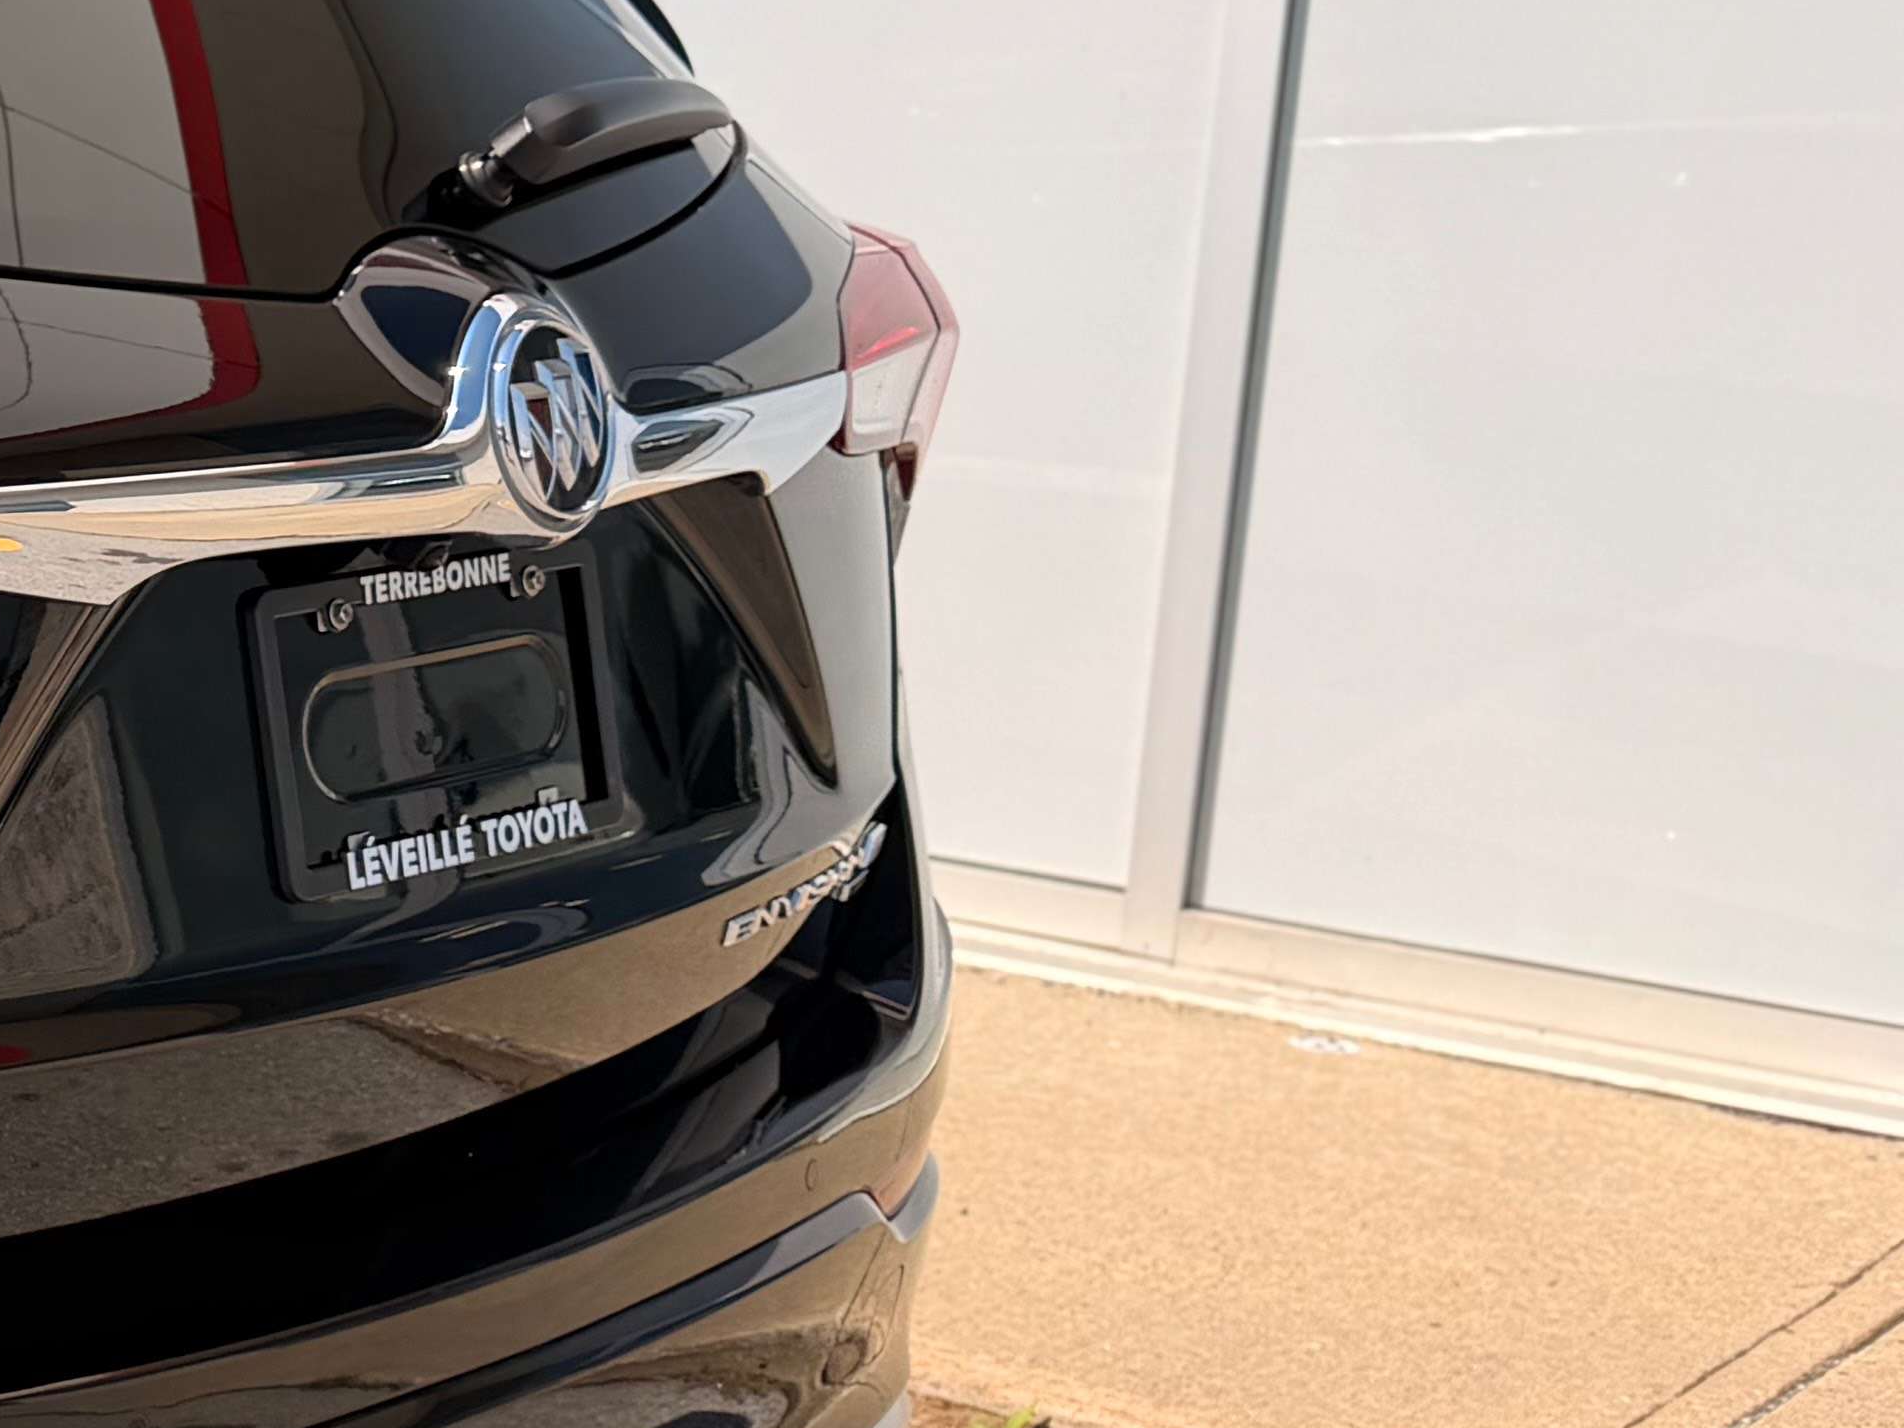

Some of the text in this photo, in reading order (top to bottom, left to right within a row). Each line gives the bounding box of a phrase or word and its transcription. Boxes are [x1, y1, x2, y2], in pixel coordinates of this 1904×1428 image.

[359, 552, 513, 606] TERREBONNE
[346, 798, 589, 890] LÉVEILLÉ TOYOTA
